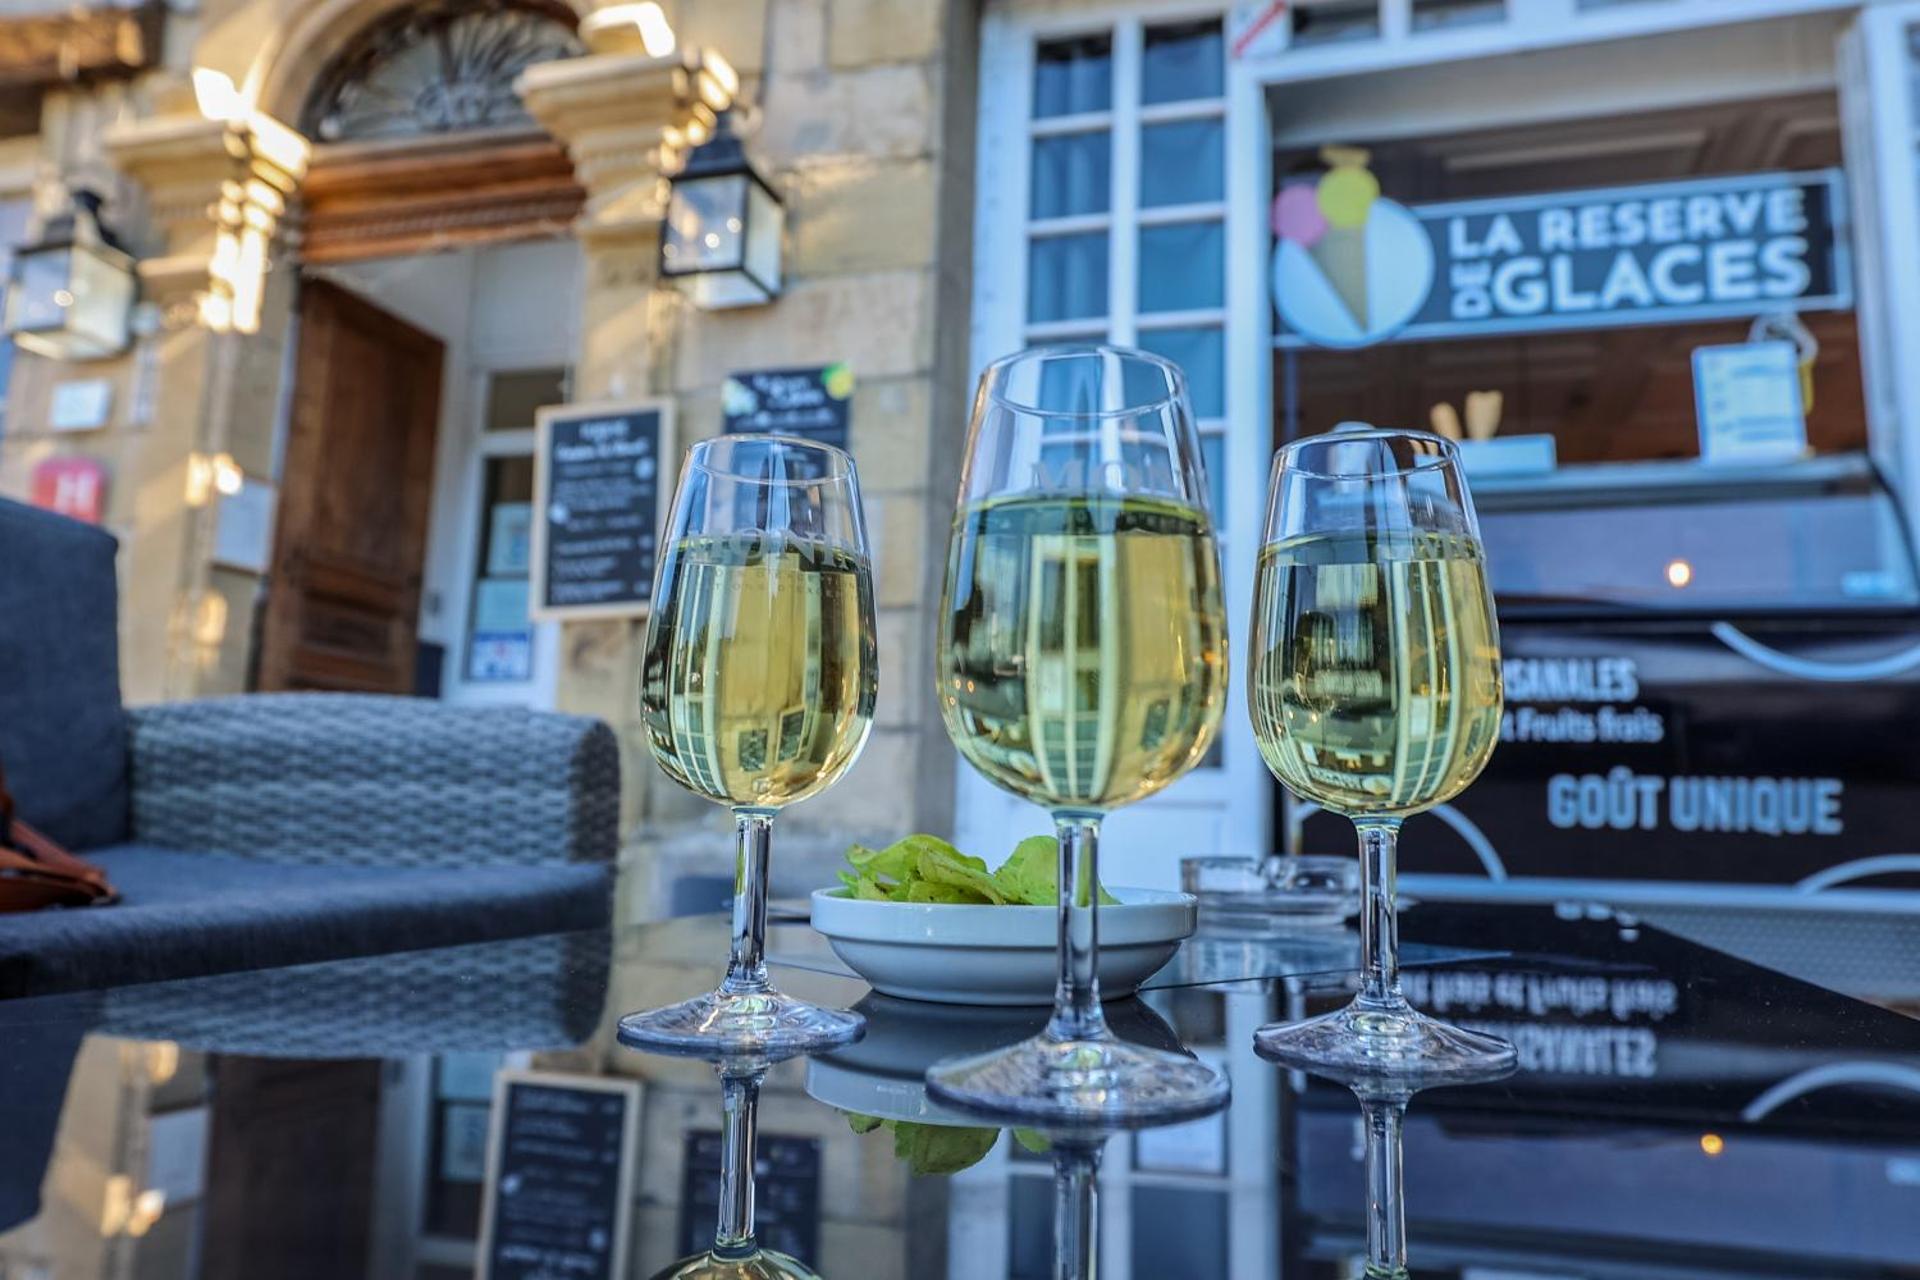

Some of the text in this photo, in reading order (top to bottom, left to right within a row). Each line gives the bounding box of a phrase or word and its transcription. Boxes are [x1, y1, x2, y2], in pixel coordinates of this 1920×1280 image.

[1449, 187, 1808, 258] LA RESERVE
[1449, 234, 1812, 320] DE GLACES
[1502, 657, 1639, 702] SANALES
[1516, 706, 1596, 743] Fruits
[1597, 705, 1664, 743] frais
[1547, 765, 1845, 836] GOÛT UNIQUE
